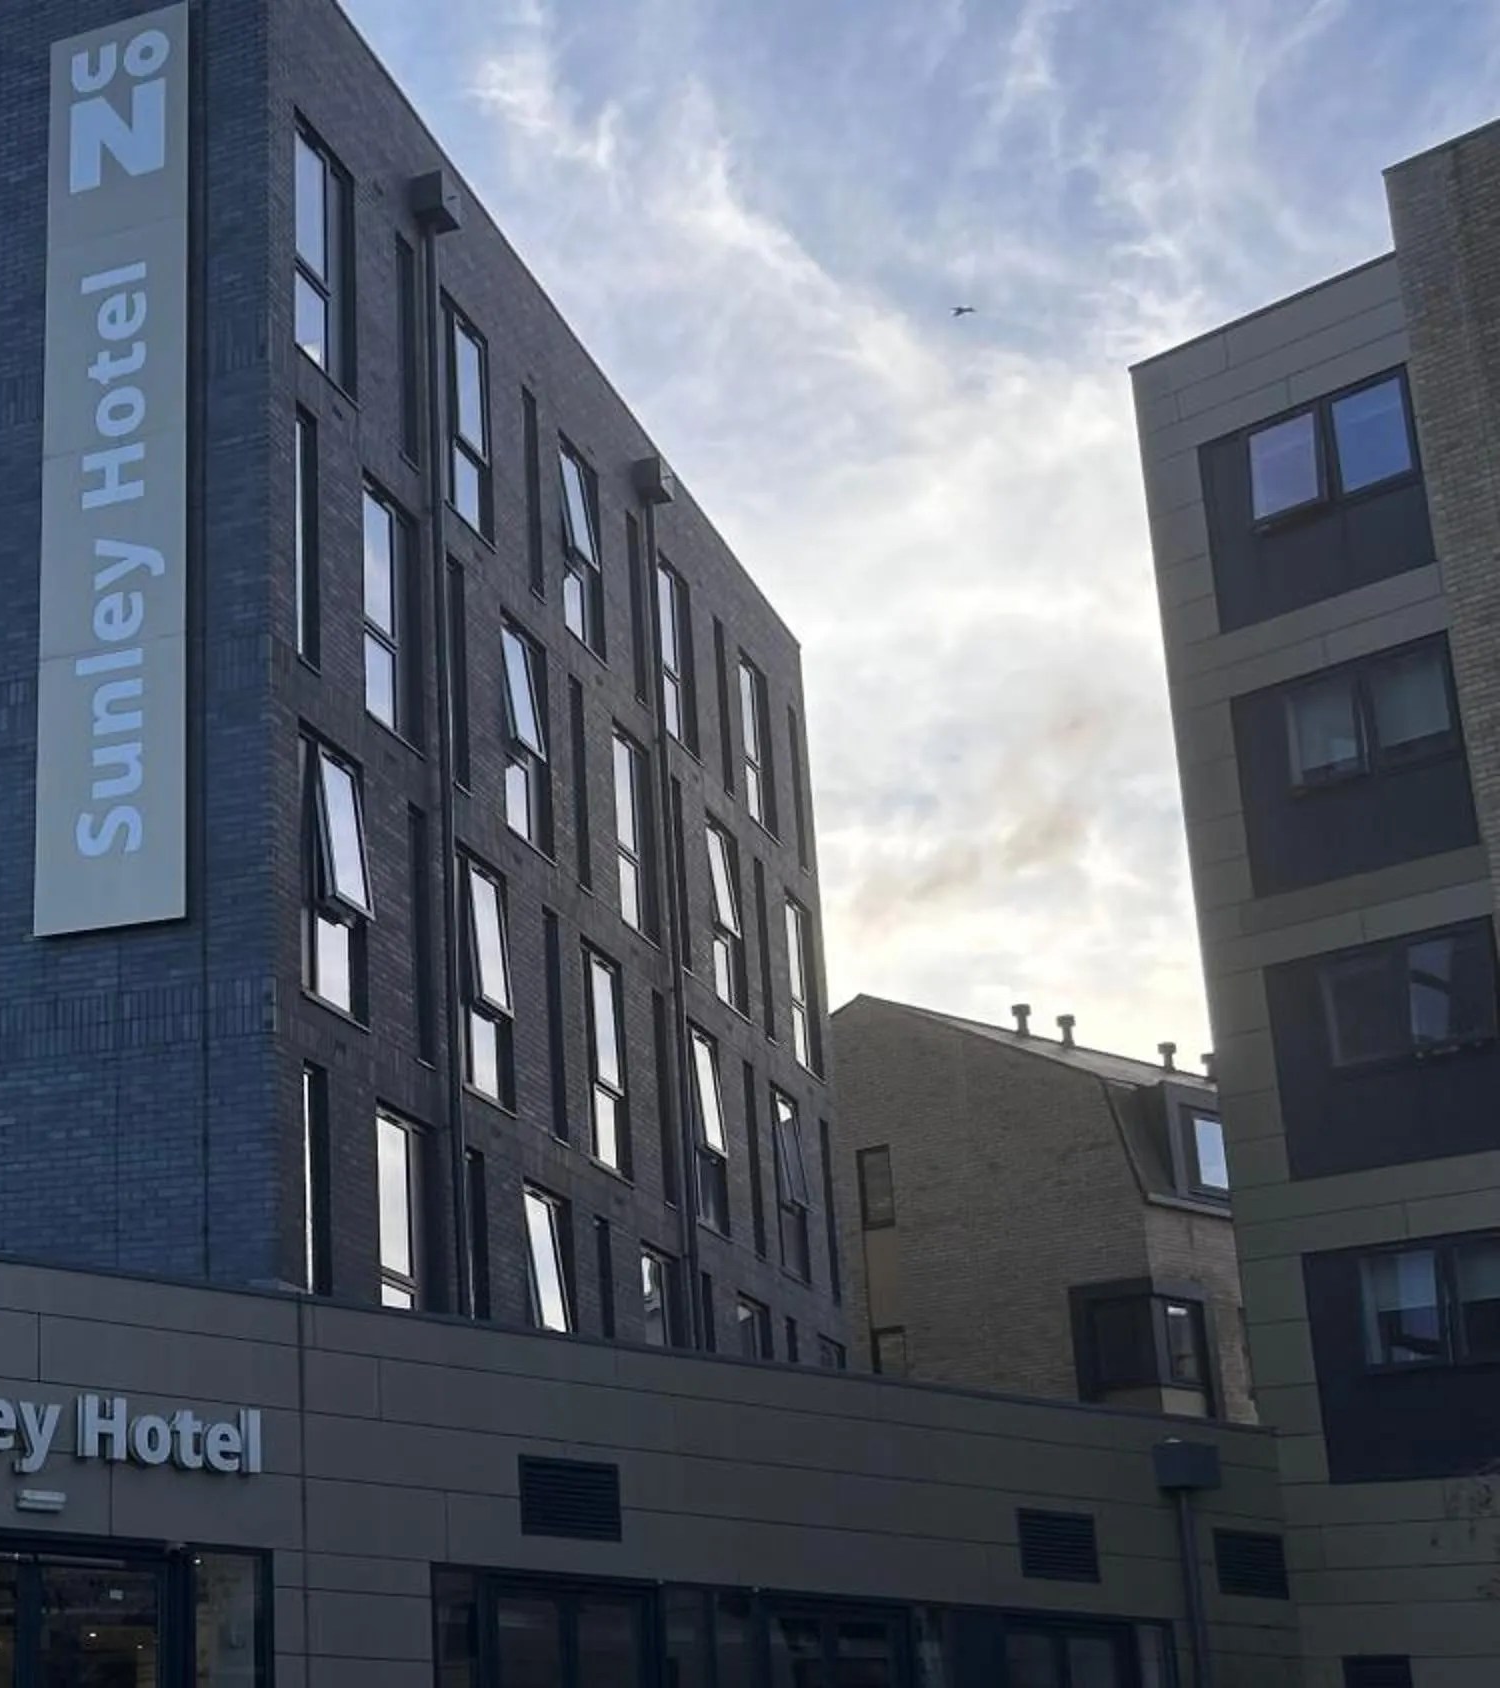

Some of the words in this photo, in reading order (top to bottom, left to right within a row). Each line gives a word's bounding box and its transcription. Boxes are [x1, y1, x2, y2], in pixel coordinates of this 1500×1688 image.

[80, 260, 148, 510] Hotel
[74, 538, 166, 857] Sunley
[76, 1393, 262, 1474] Hotel
